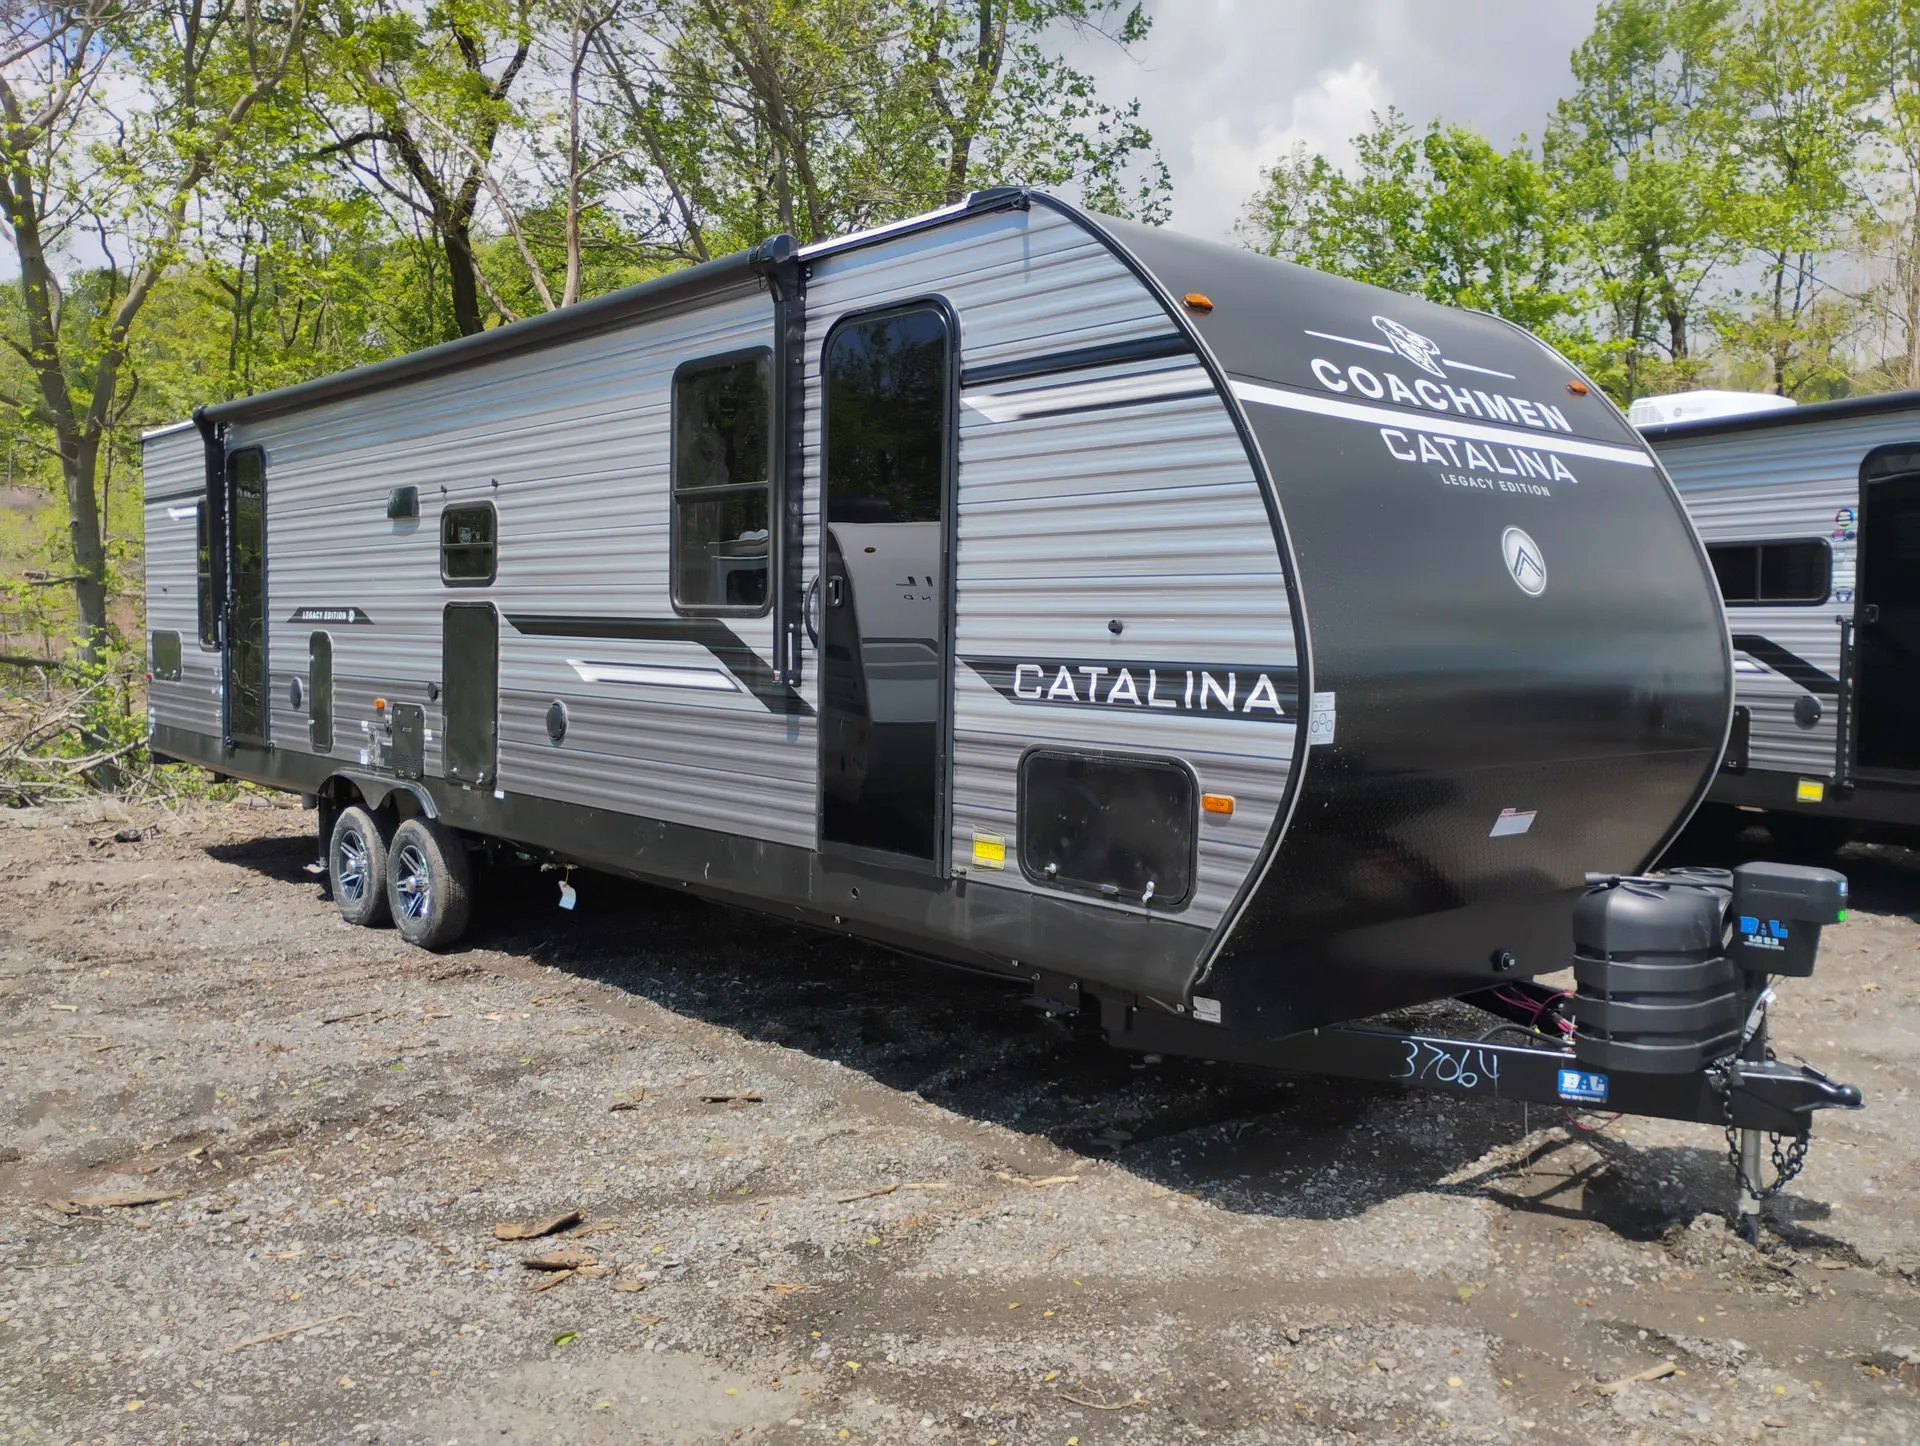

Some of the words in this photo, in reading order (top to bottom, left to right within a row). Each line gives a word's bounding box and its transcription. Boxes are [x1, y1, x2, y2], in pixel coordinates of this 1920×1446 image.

[1310, 358, 1573, 432] COACHMEN
[1380, 428, 1578, 484] CATALINA
[1440, 473, 1494, 490] LEGACY
[1498, 480, 1551, 497] EDITION
[302, 610, 323, 620] LEGACY
[323, 611, 347, 620] EDITION
[1013, 664, 1285, 715] CATALINA
[1389, 1040, 1500, 1092] 37064
